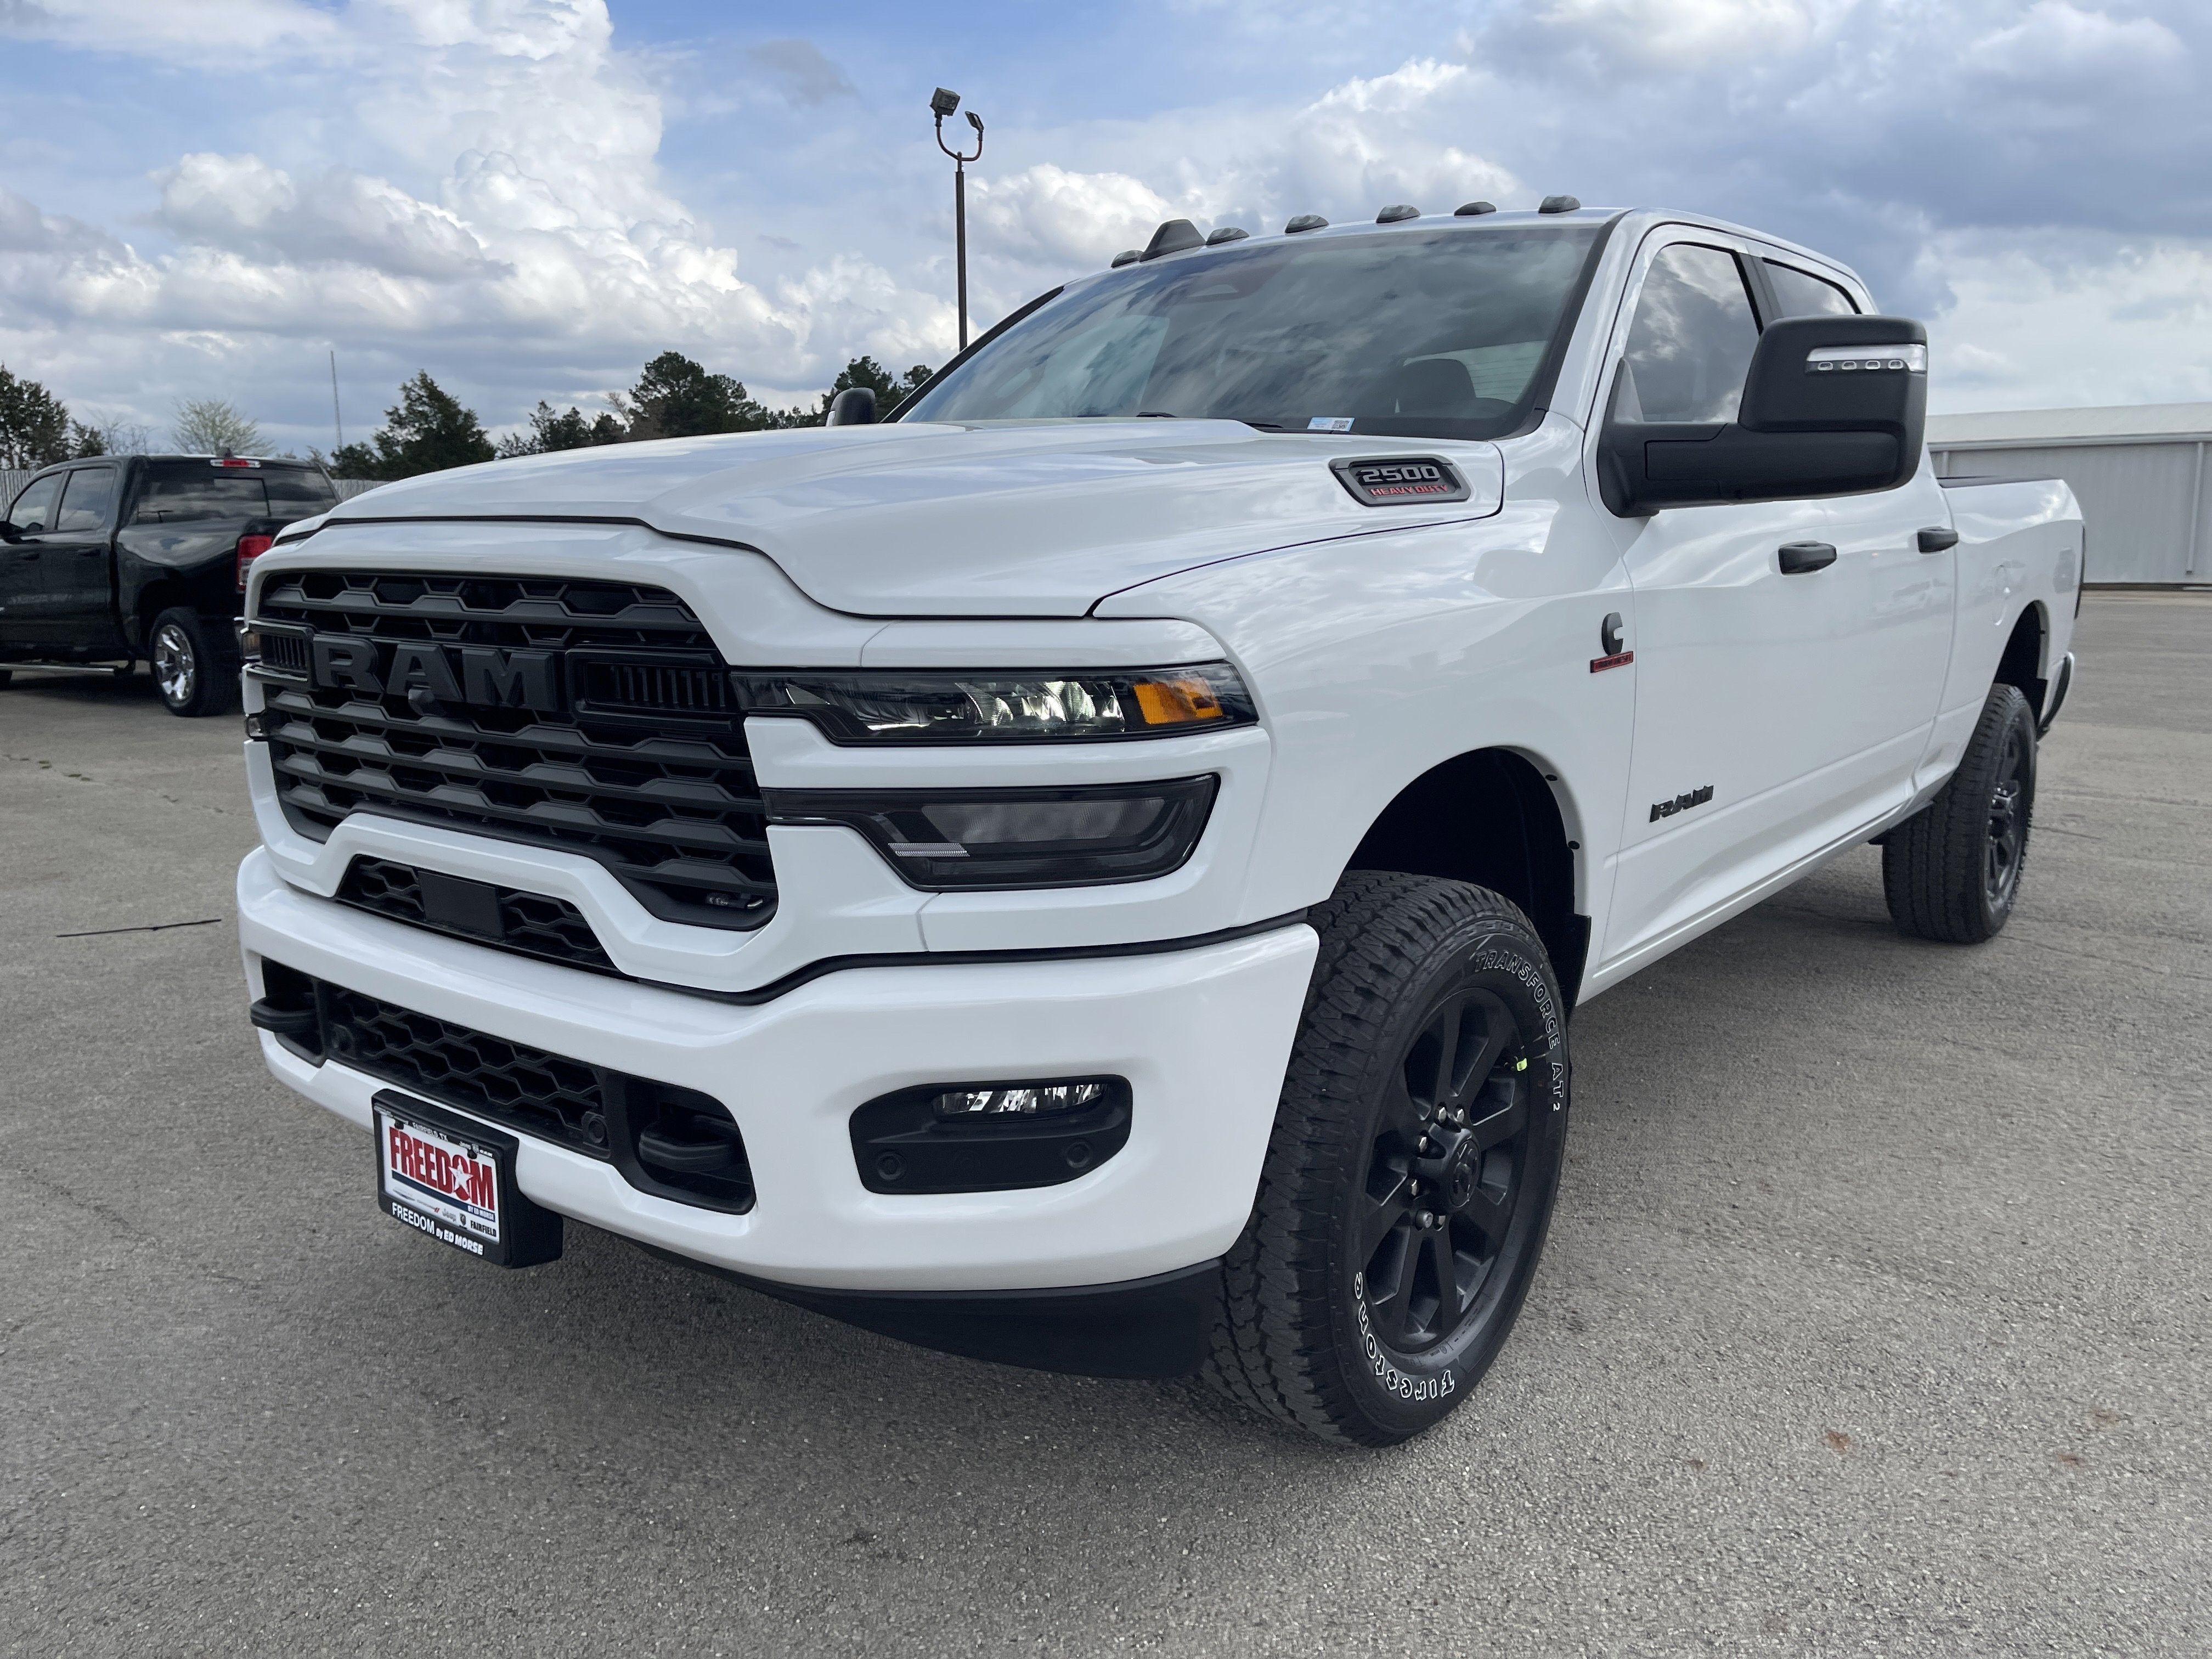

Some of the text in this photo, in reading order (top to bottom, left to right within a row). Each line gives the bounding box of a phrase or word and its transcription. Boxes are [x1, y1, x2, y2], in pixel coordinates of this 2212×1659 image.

[1359, 465, 1441, 484] 2500
[1370, 484, 1448, 496] HEAVY DUTY
[313, 634, 556, 712] RAM
[1649, 785, 1714, 823] RAM
[1474, 950, 1561, 1050] TRANSFORCE
[389, 1126, 495, 1211] FREEDOM
[392, 1202, 435, 1235] FREEDOM
[443, 1229, 454, 1243] ED
[455, 1234, 484, 1256] MORSE
[470, 1220, 496, 1237] FAIRFIELD
